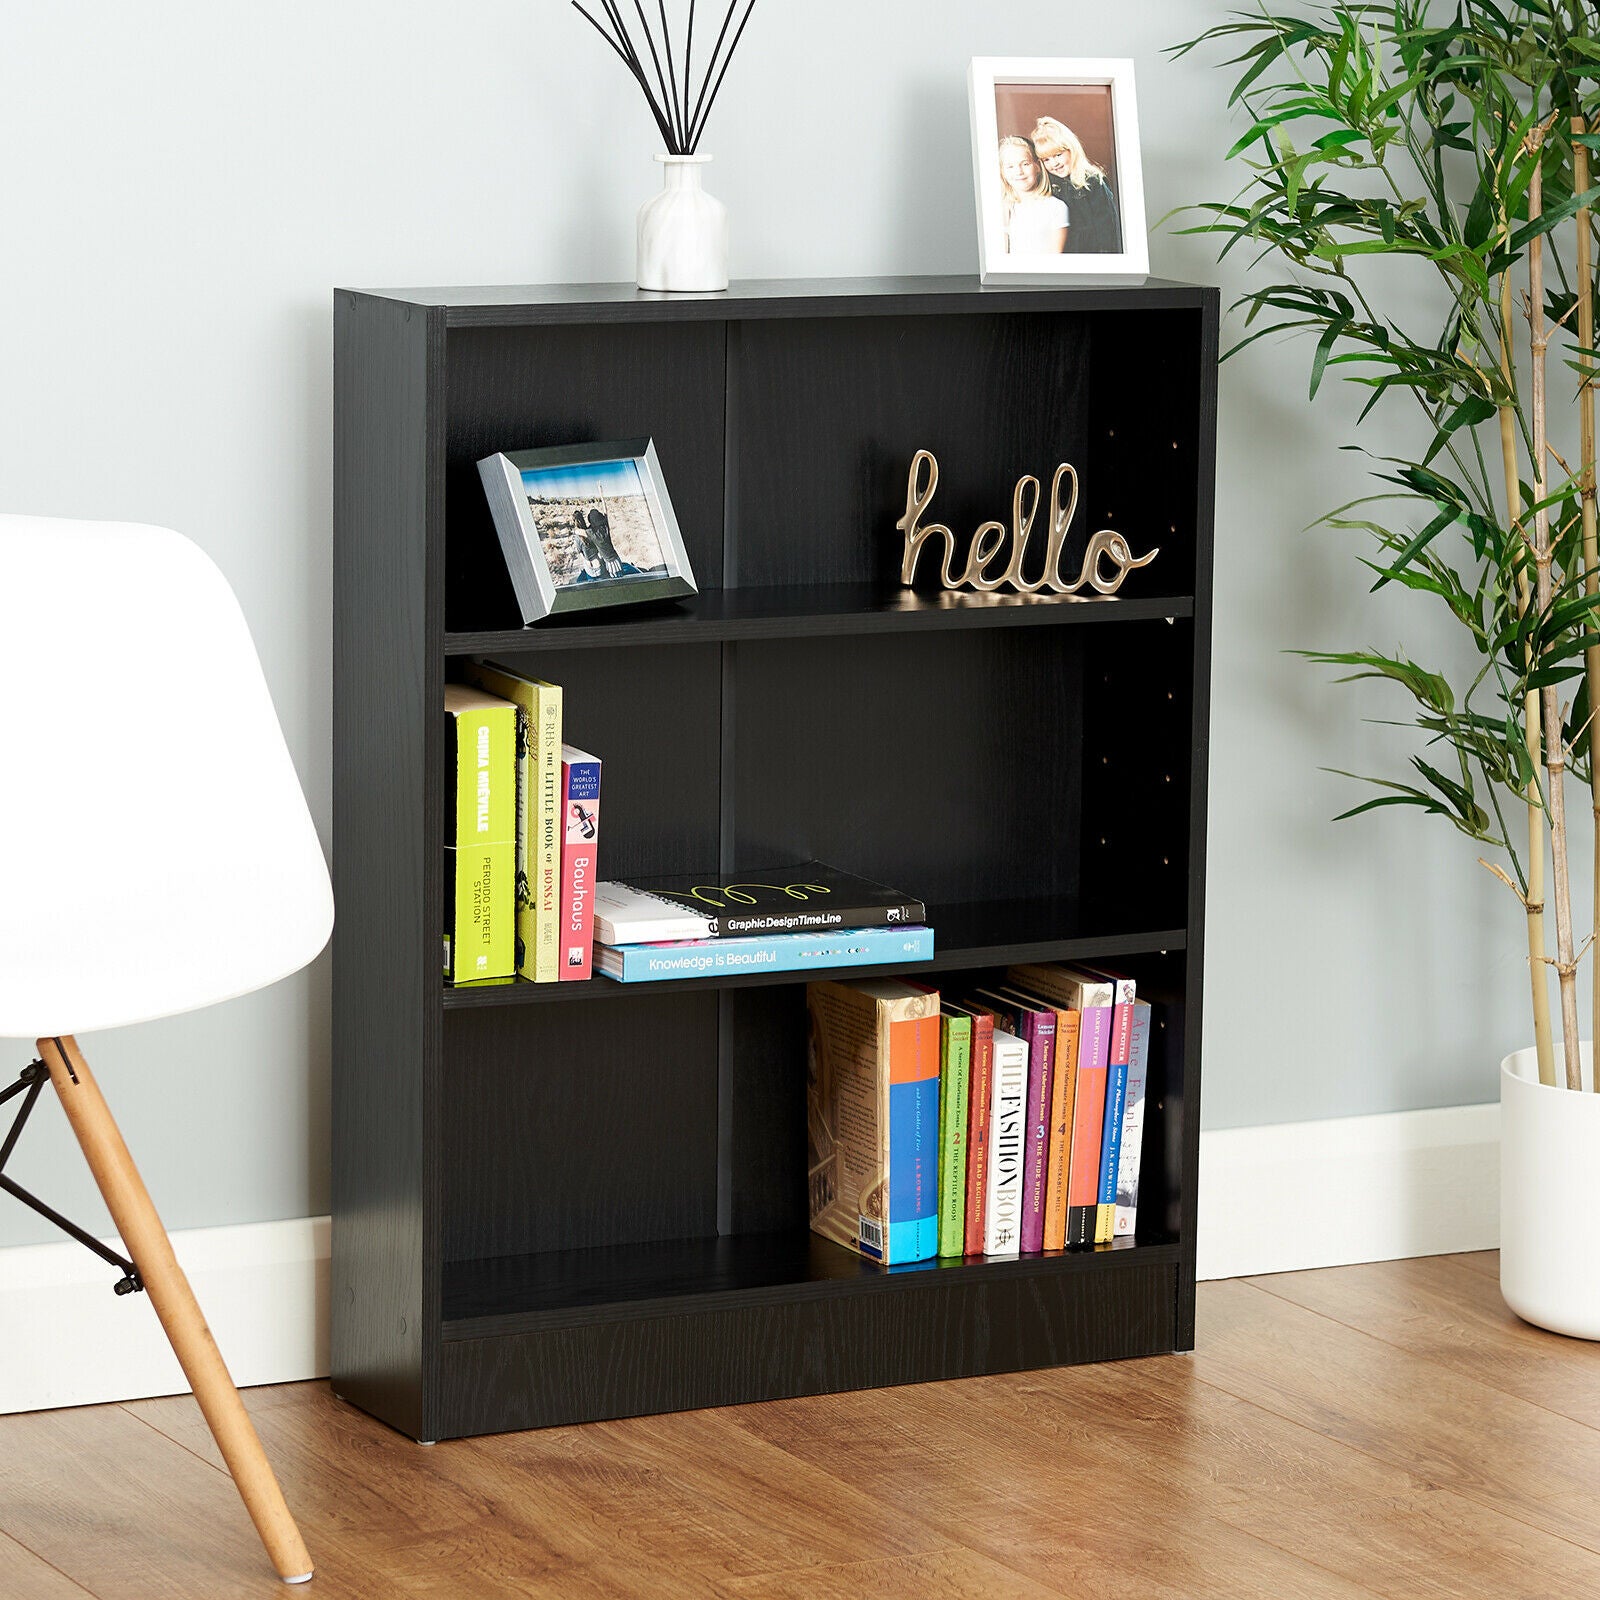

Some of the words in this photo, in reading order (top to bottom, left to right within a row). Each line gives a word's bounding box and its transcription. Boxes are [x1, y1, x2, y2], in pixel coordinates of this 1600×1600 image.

[896, 449, 1160, 594] hello
[477, 726, 490, 768] CHINA
[545, 723, 555, 747] RHS
[545, 772, 555, 813] LITTLE
[571, 783, 597, 791] GREATEST
[572, 776, 597, 784] WORLD'S
[477, 770, 491, 832] MIÉVILLE
[544, 819, 554, 850] BOOK
[545, 853, 553, 863] OF
[482, 857, 491, 904] PERDIDO
[543, 869, 554, 911] BONSAI
[571, 857, 589, 931] Bauhaus
[473, 881, 482, 924] STATION
[482, 905, 491, 945] STREET
[649, 956, 712, 971] Knowledge
[715, 953, 724, 966] is
[726, 950, 776, 966] Beautiful
[1121, 1006, 1129, 1032] HARRY
[1092, 1036, 1100, 1066] POTTER
[1118, 1033, 1127, 1062] POTTER
[1130, 1018, 1146, 1066] Anne
[1040, 1071, 1048, 1102] Unfortunate
[1125, 1079, 1141, 1133] Frank
[953, 1132, 961, 1145] 2
[1036, 1125, 1045, 1138] 3
[1058, 1123, 1066, 1135] 4
[974, 1181, 982, 1223] BEGINNING
